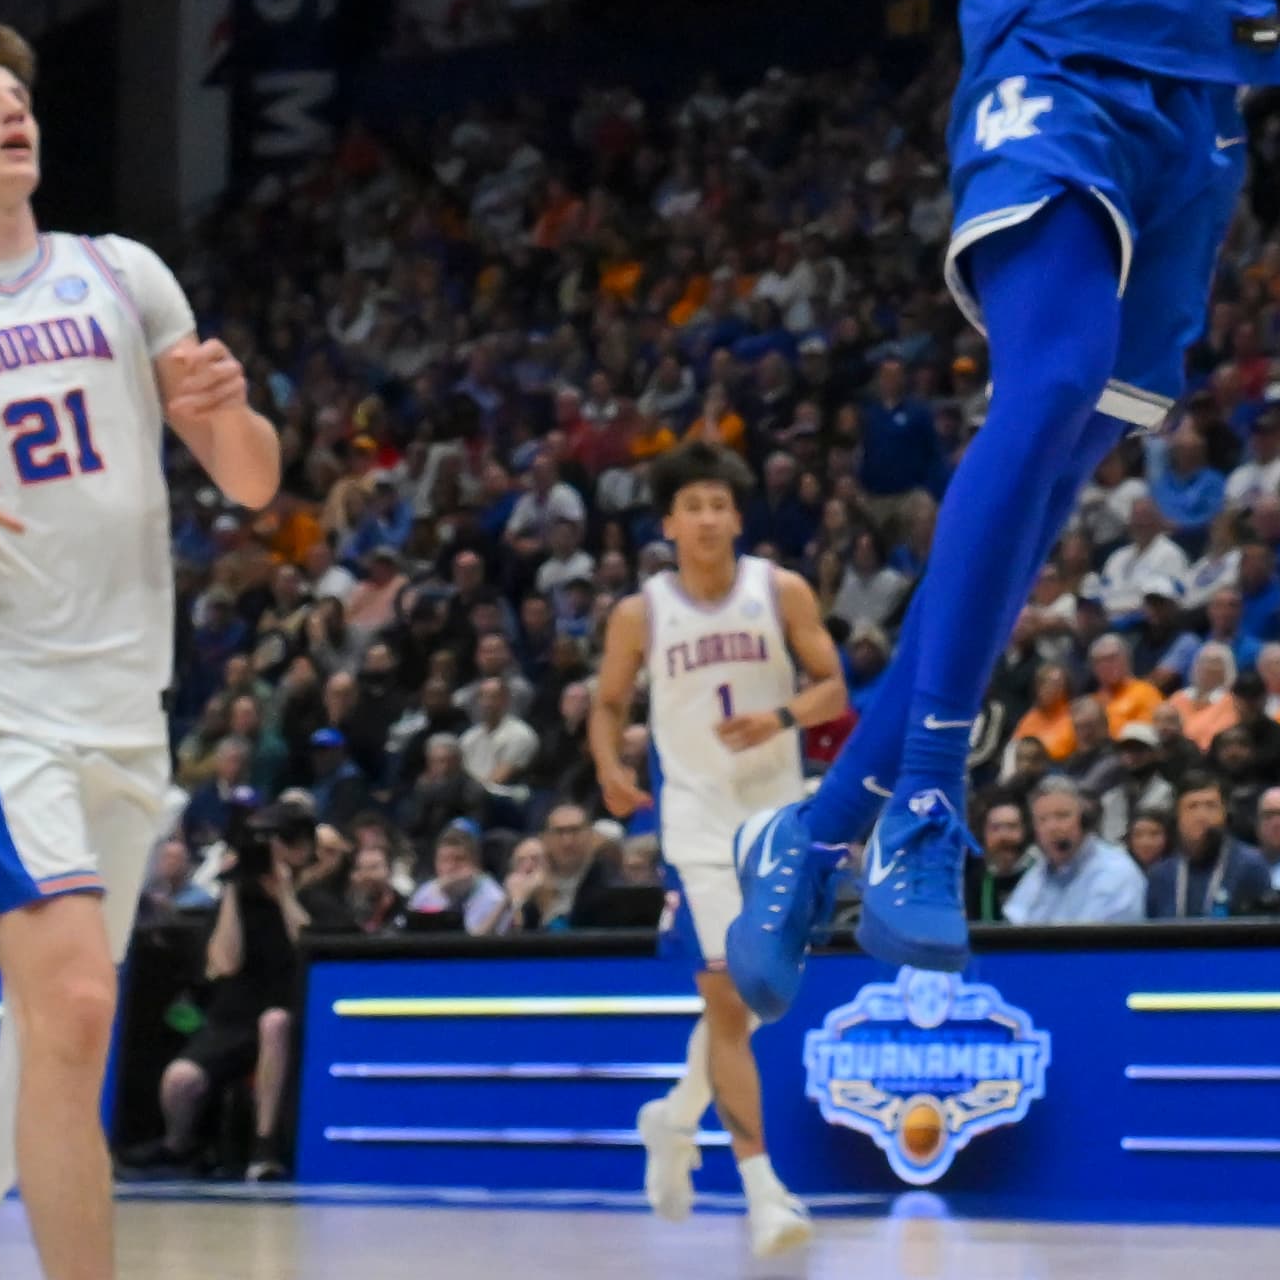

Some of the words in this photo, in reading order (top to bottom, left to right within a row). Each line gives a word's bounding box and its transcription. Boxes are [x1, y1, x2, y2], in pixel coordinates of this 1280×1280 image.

[2, 388, 106, 486] 21
[716, 683, 734, 720] 1
[816, 1042, 1041, 1084] TOURNAMENT
